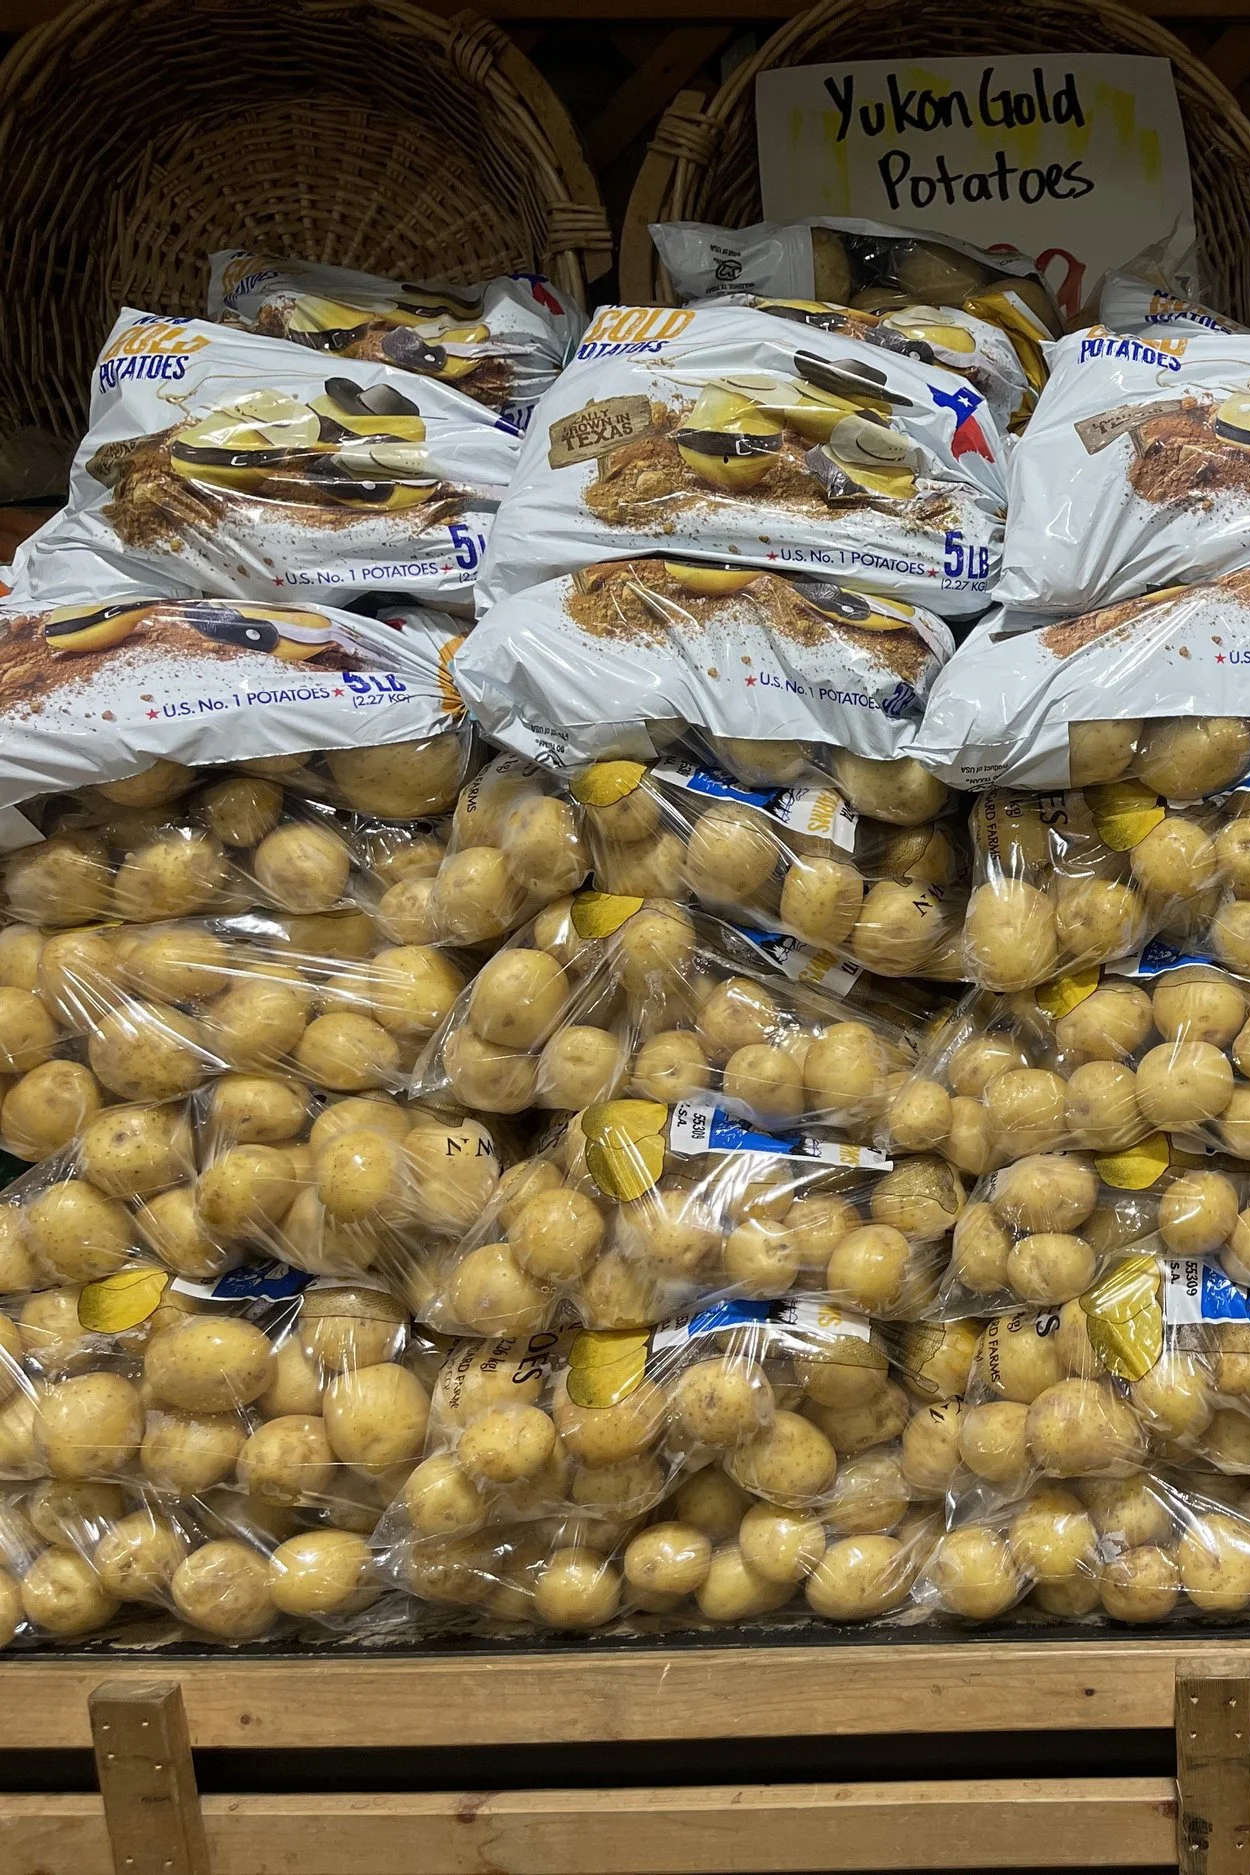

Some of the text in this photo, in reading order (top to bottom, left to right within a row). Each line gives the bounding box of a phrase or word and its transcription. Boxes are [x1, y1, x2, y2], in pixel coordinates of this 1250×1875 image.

[824, 67, 1085, 141] Yukon Gold
[879, 151, 1094, 209] Potatoes
[584, 308, 696, 343] GOLD
[1078, 338, 1181, 372] POTATOES
[100, 355, 189, 393] POTATOES
[616, 412, 630, 424] IN
[562, 422, 634, 451] TEXAS
[285, 562, 439, 585] U.S. No. 1 POTATOES
[781, 549, 925, 575] U.S. No. 1 POTATOES
[163, 685, 330, 718] U.S. No. 1 POTATOES
[353, 695, 383, 709] (2.27
[760, 672, 783, 690] U.S.
[786, 682, 807, 695] No.
[809, 687, 815, 698] 1
[467, 776, 484, 813] FARMS
[808, 791, 841, 833] FARMS
[986, 824, 1001, 860] FARMS
[1185, 1261, 1199, 1296] 55309
[988, 1340, 1001, 1383] FARMS
